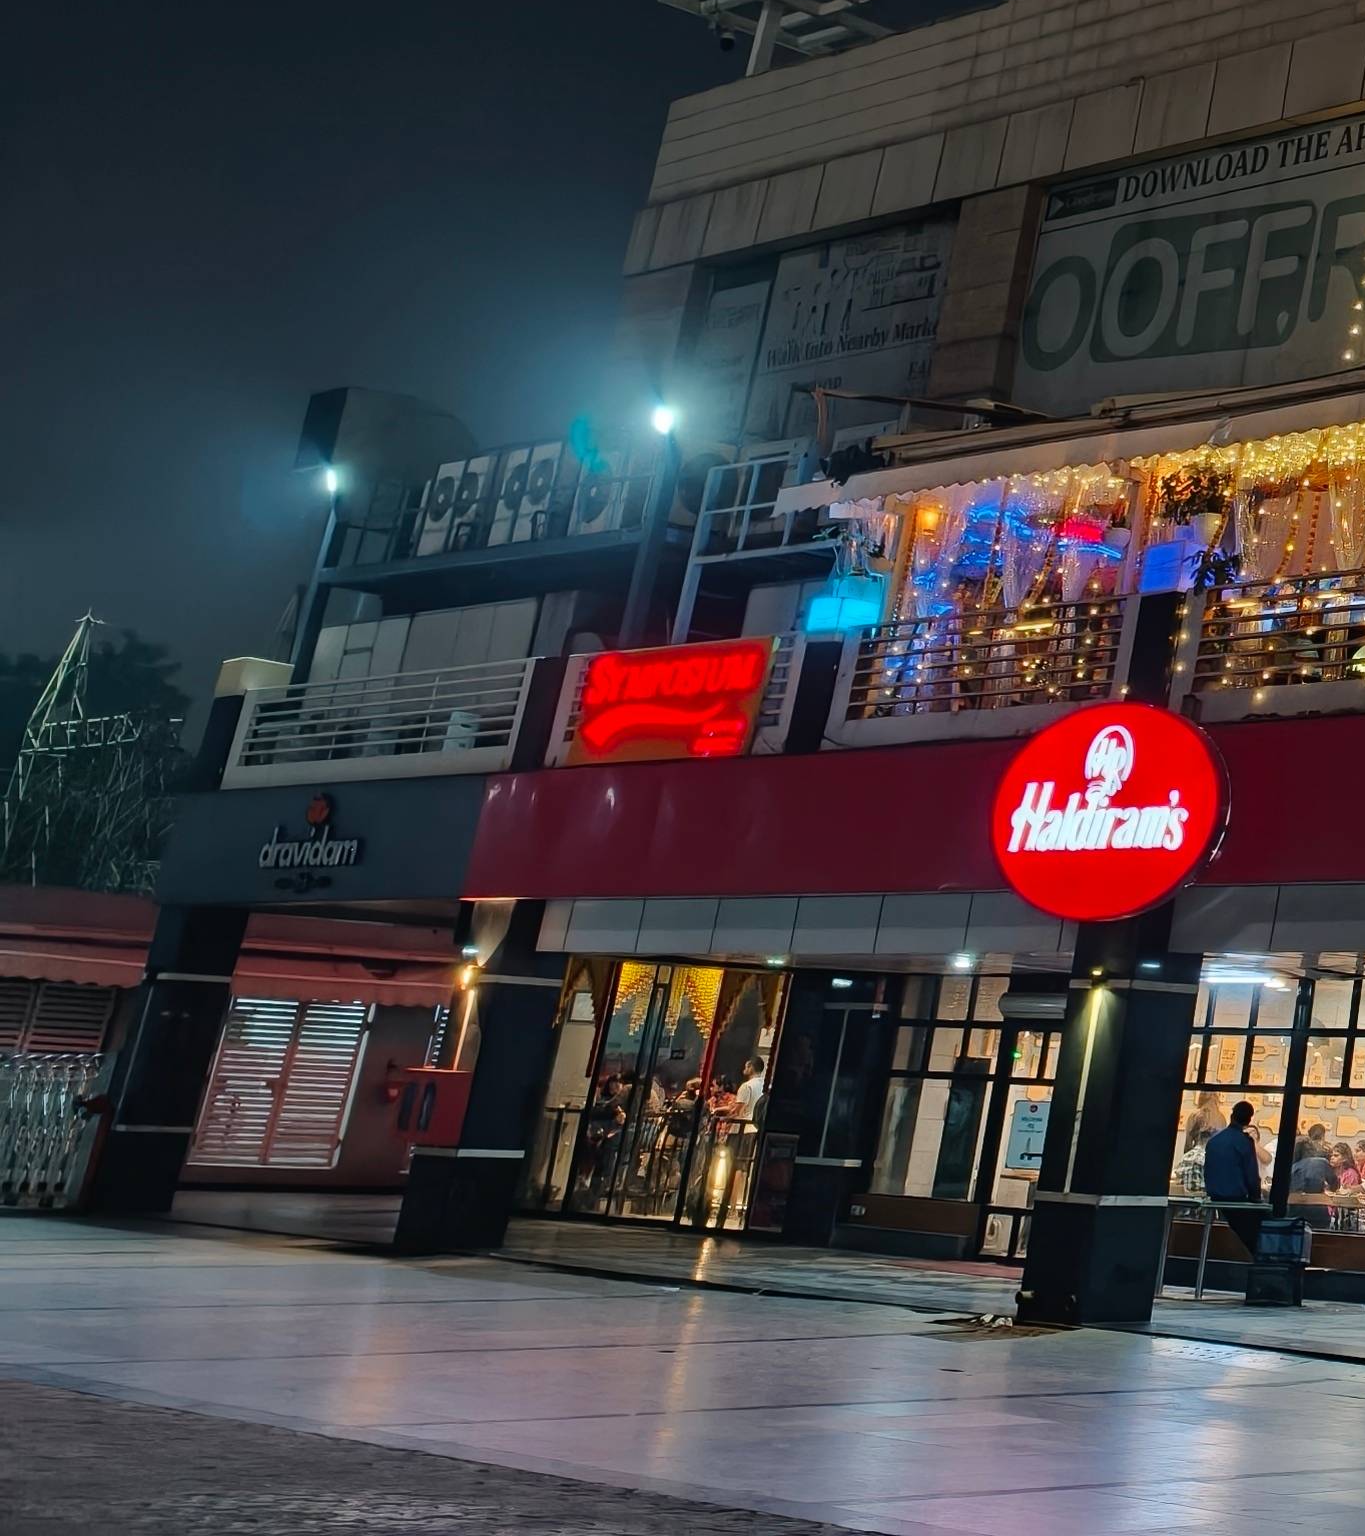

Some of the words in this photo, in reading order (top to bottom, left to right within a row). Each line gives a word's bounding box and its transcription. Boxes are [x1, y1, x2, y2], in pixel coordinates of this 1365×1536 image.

[1121, 145, 1269, 204] DOWNLOAD
[1277, 130, 1329, 168] THE
[259, 825, 358, 867] dravidam
[1008, 781, 1189, 852] Haldiram's
